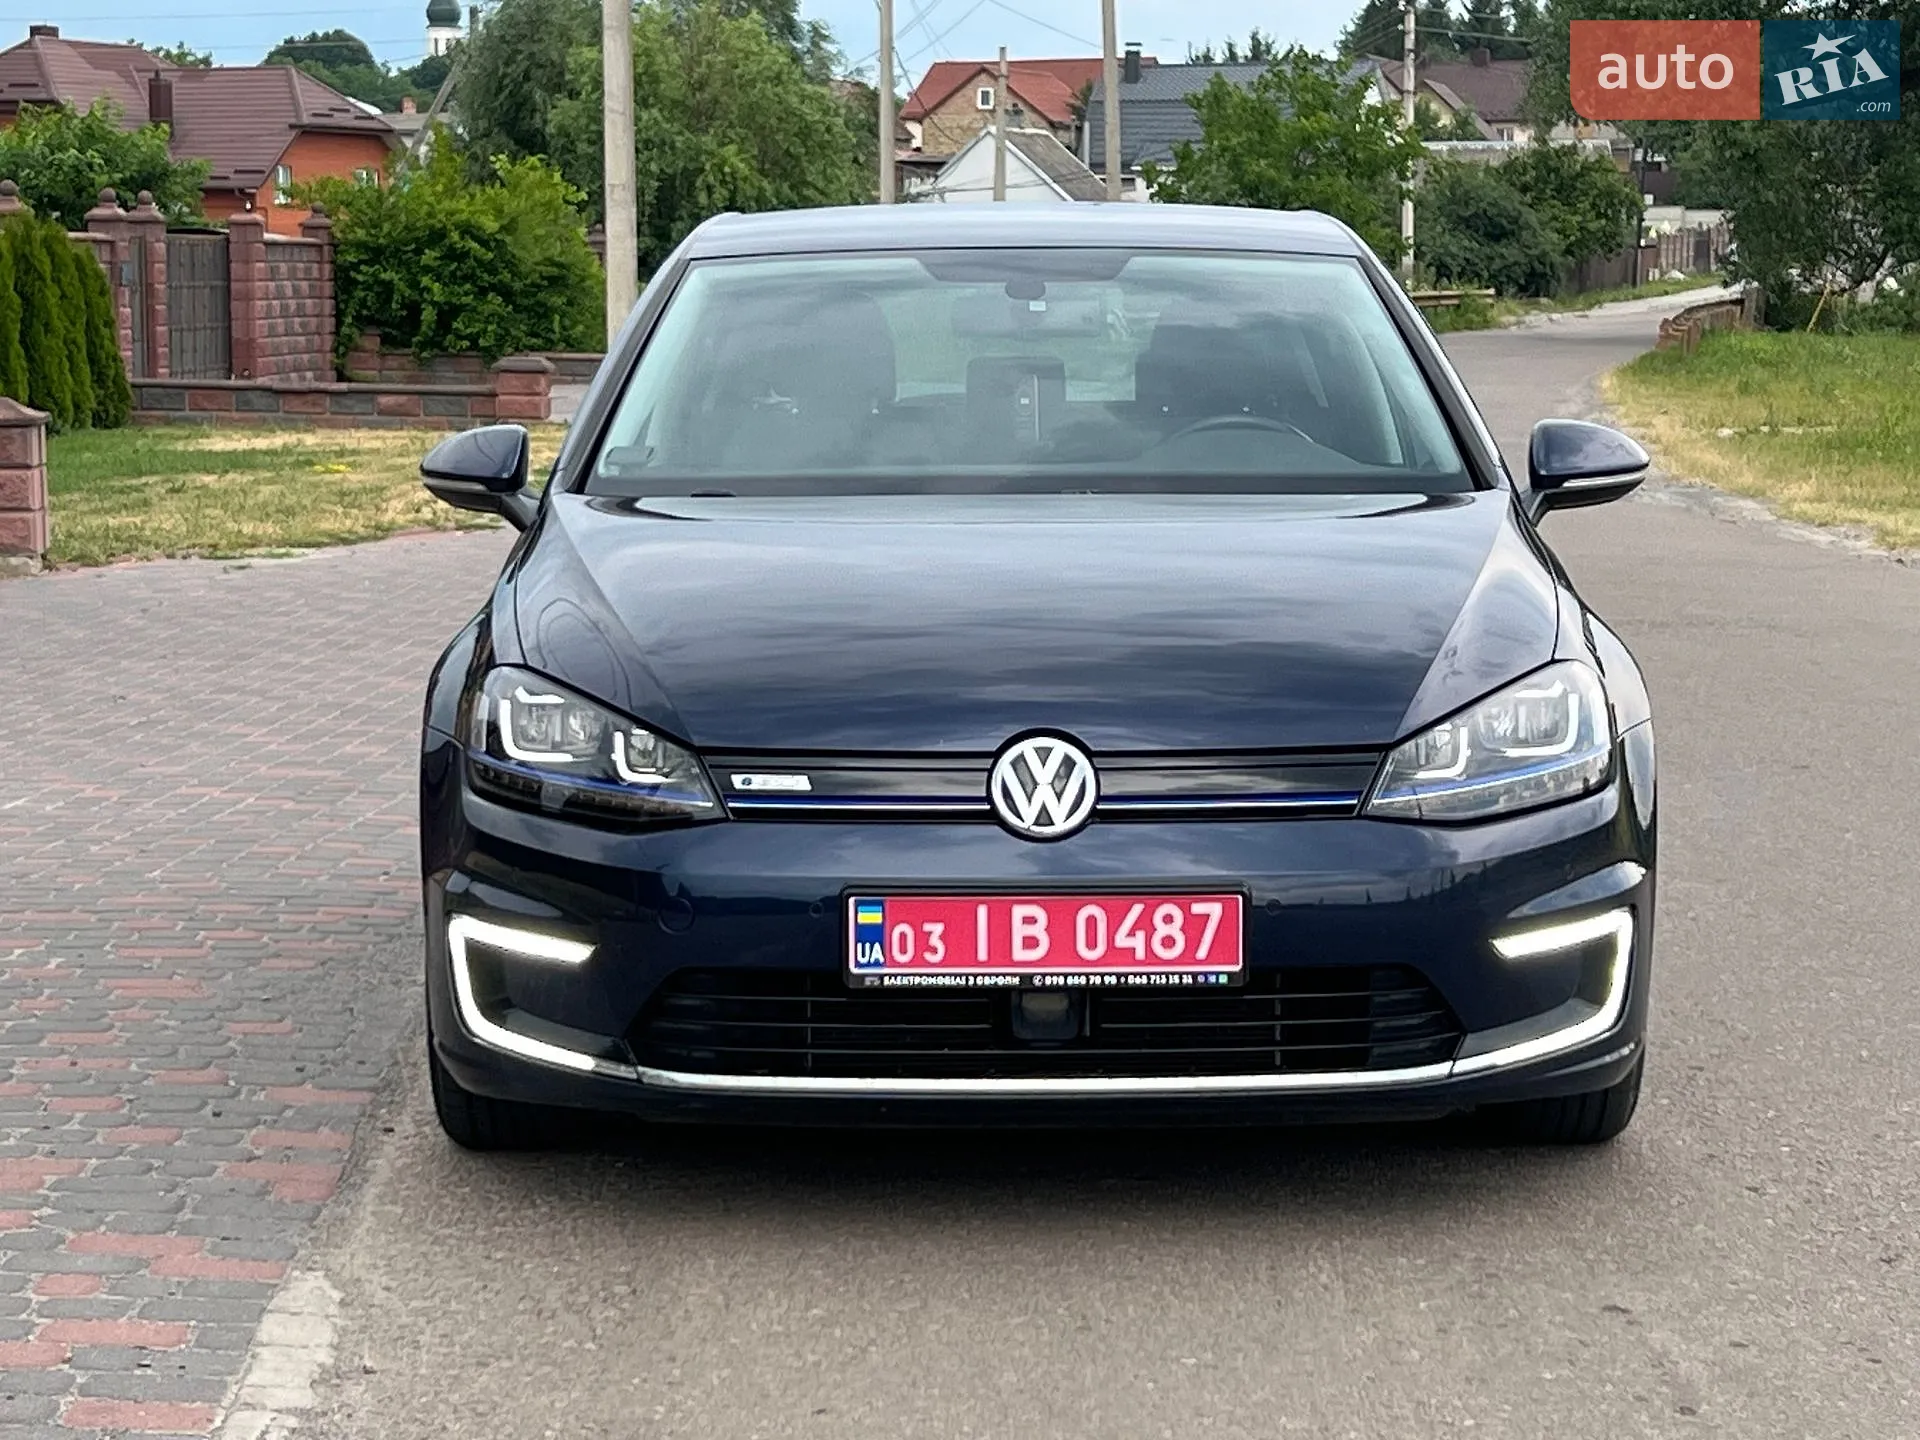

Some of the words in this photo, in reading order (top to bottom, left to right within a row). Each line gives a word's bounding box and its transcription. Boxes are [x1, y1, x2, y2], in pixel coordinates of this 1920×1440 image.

[994, 739, 1092, 832] VW
[856, 942, 884, 963] UA
[891, 922, 947, 964] 03
[1075, 902, 1224, 961] 0487
